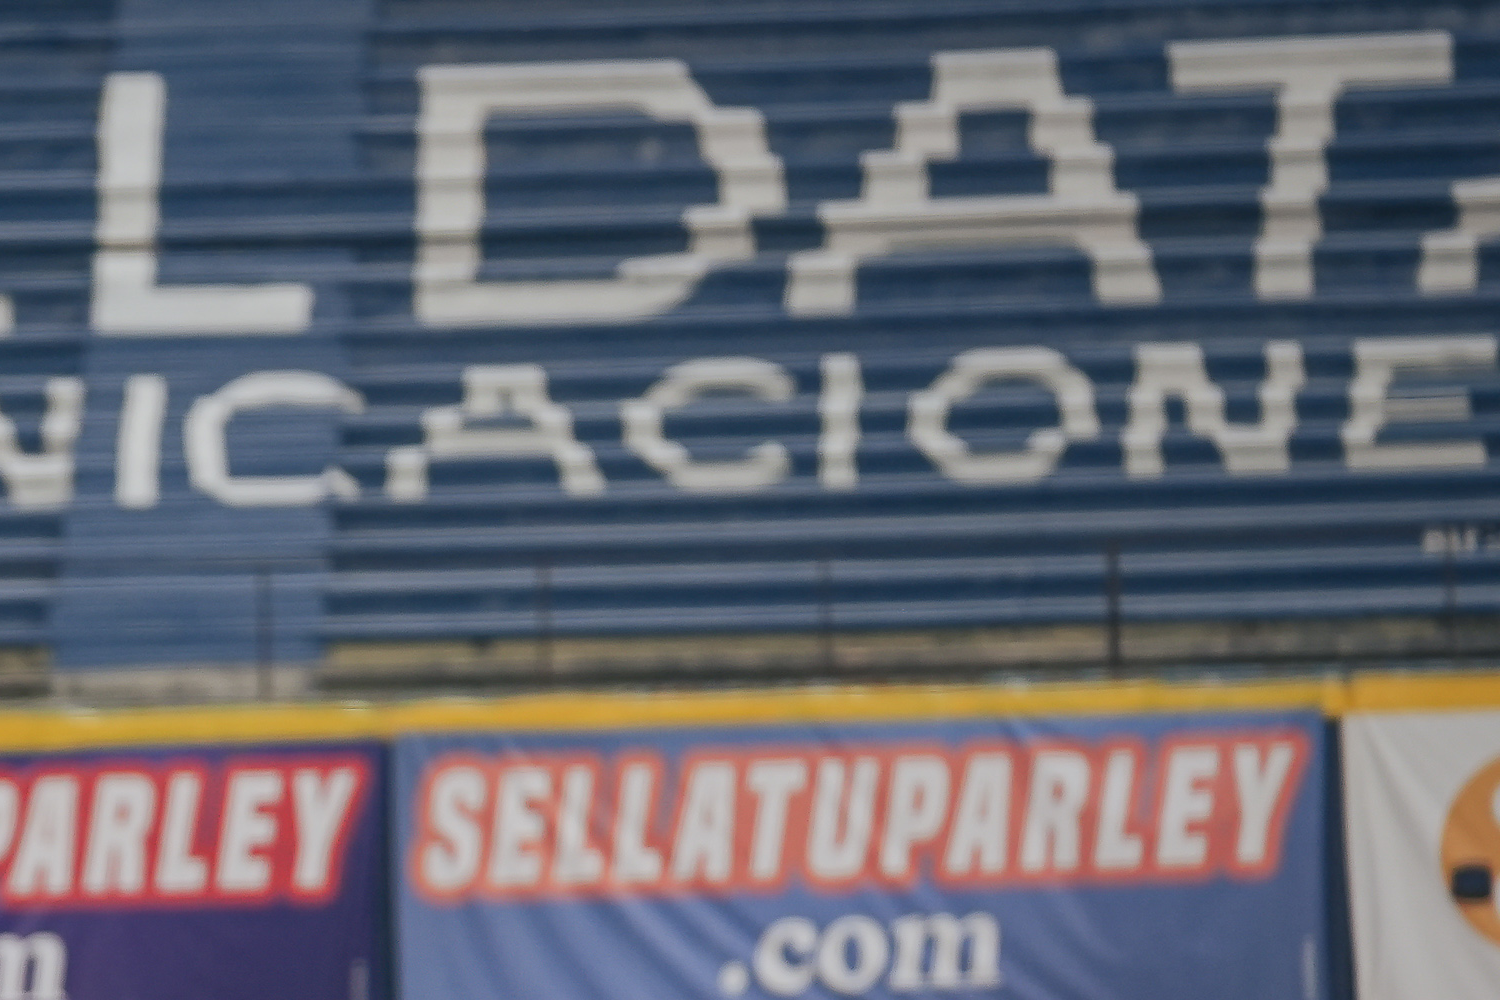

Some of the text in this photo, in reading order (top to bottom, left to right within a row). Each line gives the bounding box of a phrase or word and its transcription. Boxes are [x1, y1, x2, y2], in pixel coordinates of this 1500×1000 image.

[412, 29, 1500, 328] DAT
[416, 738, 1302, 896] SELLATUPARLEY
[717, 910, 1002, 997] .com
